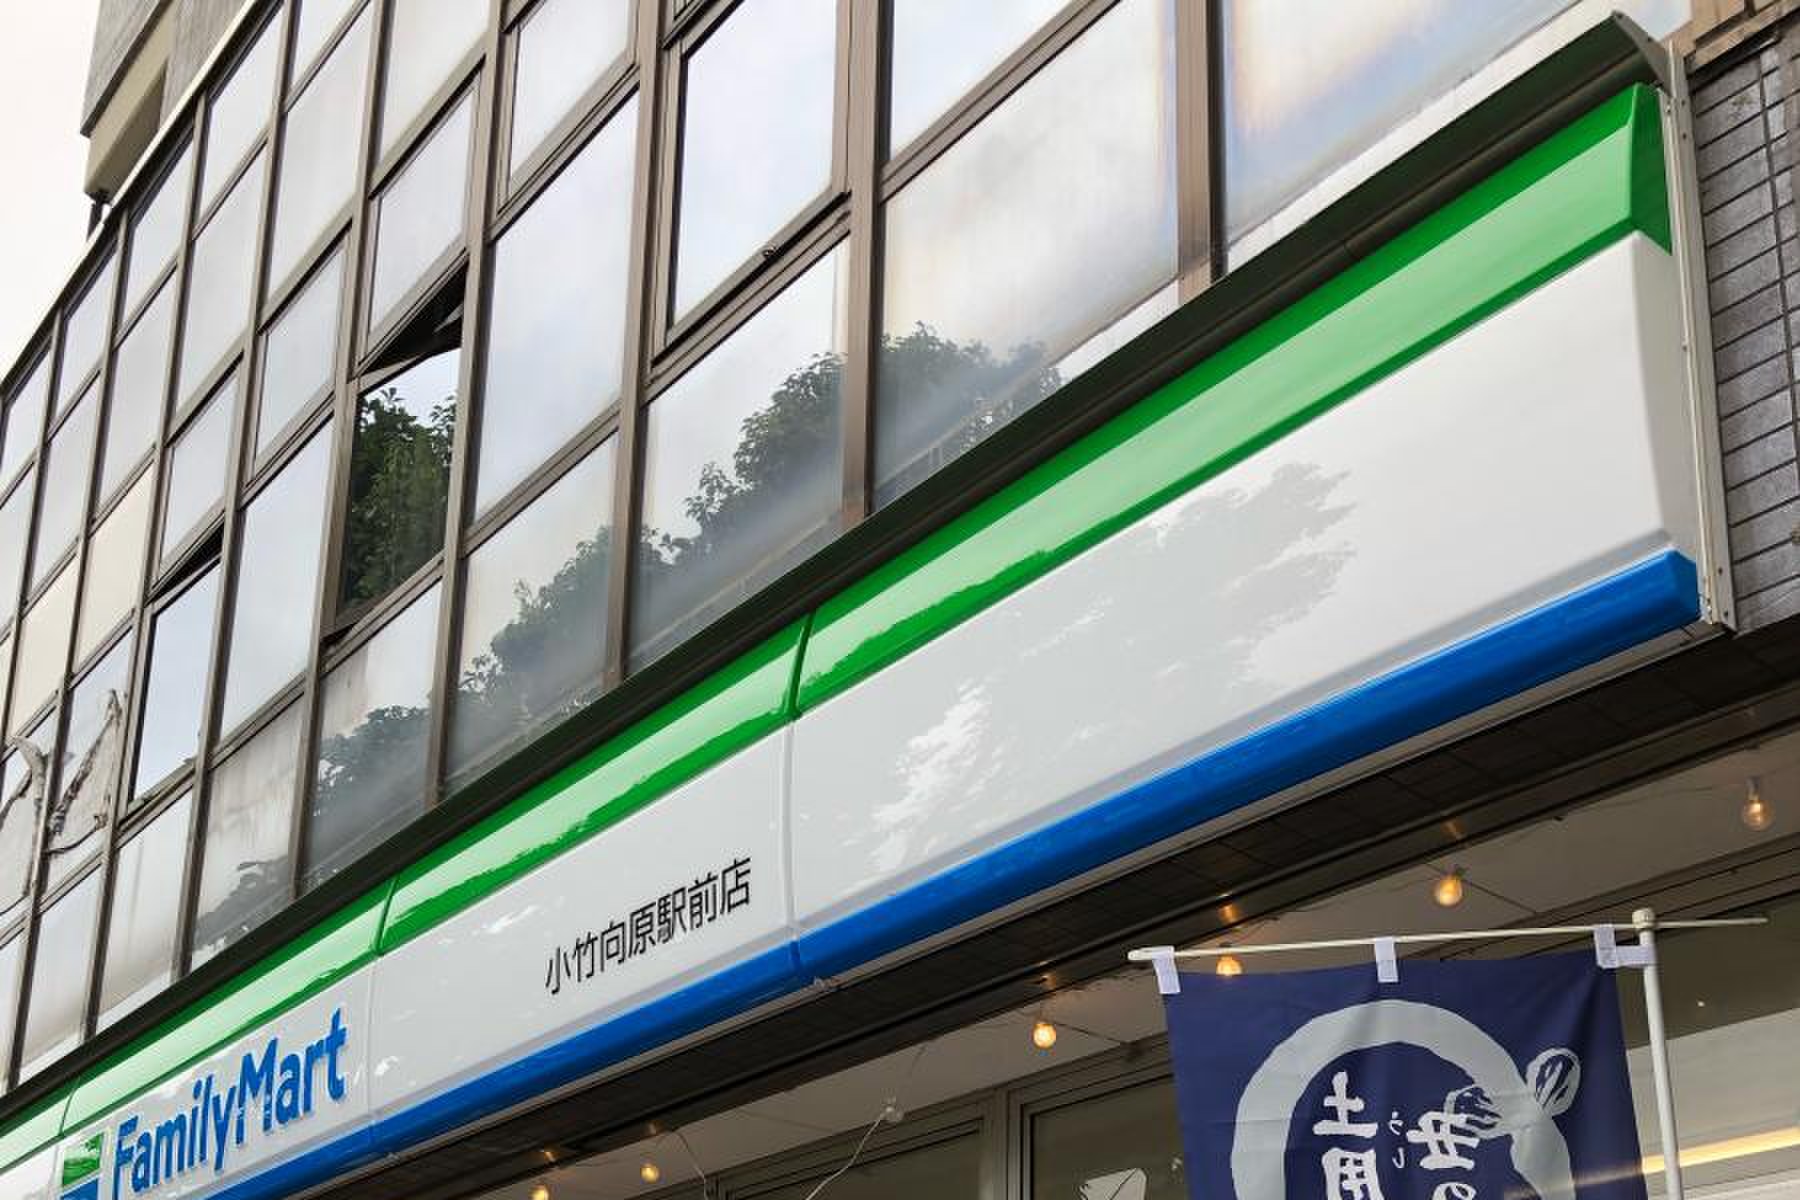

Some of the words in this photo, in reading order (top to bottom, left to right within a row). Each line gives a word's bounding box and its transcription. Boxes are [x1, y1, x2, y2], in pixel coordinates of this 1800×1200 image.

[545, 857, 751, 994] 小竹向原駅前店
